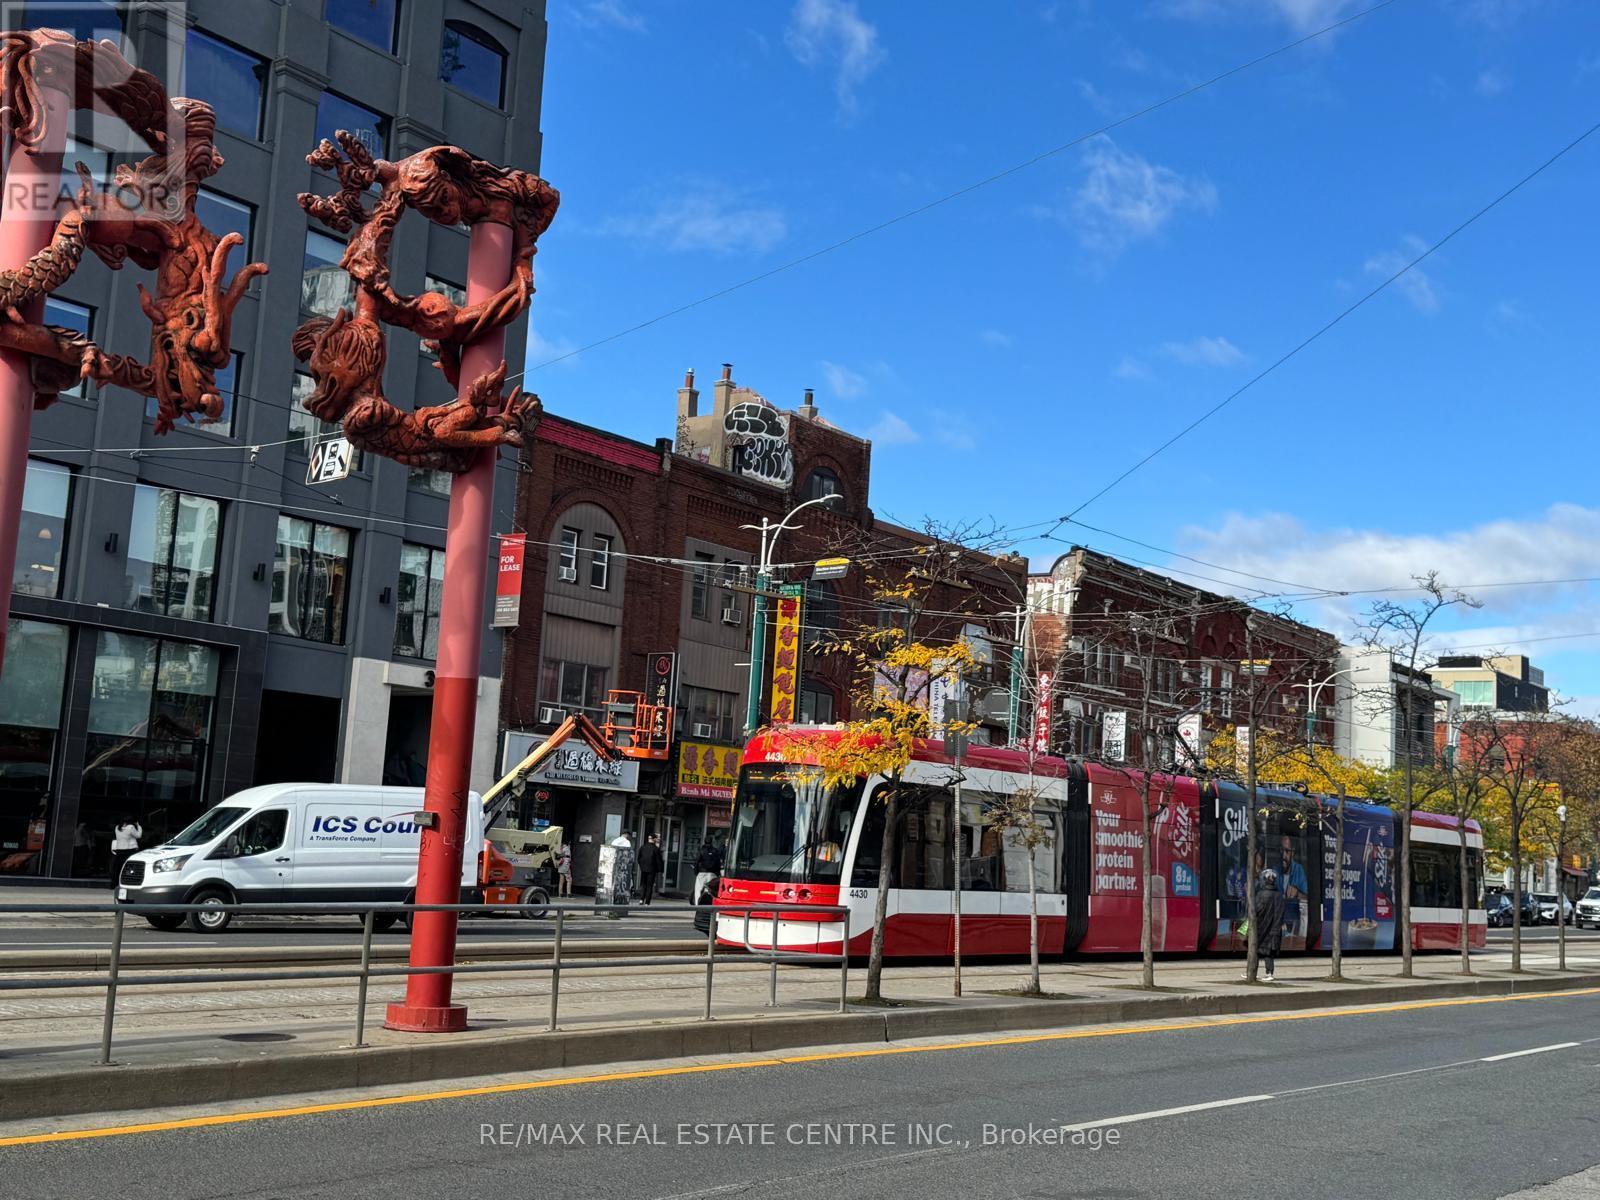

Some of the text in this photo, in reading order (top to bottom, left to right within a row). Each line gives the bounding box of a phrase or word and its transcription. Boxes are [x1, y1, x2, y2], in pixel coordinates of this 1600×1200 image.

[500, 564, 521, 572] LEASE
[501, 555, 515, 564] FOR
[312, 815, 359, 833] ICS
[1095, 809, 1121, 827] Your
[1222, 805, 1249, 847] Silk
[1173, 801, 1190, 857] Silk
[1095, 829, 1144, 849] smoothie
[1095, 850, 1134, 870] protein
[1324, 851, 1352, 866] cerl's
[1095, 872, 1138, 893] partner.
[1341, 869, 1362, 885] sugar
[849, 889, 868, 899] 4430
[1324, 883, 1356, 900] sidick.
